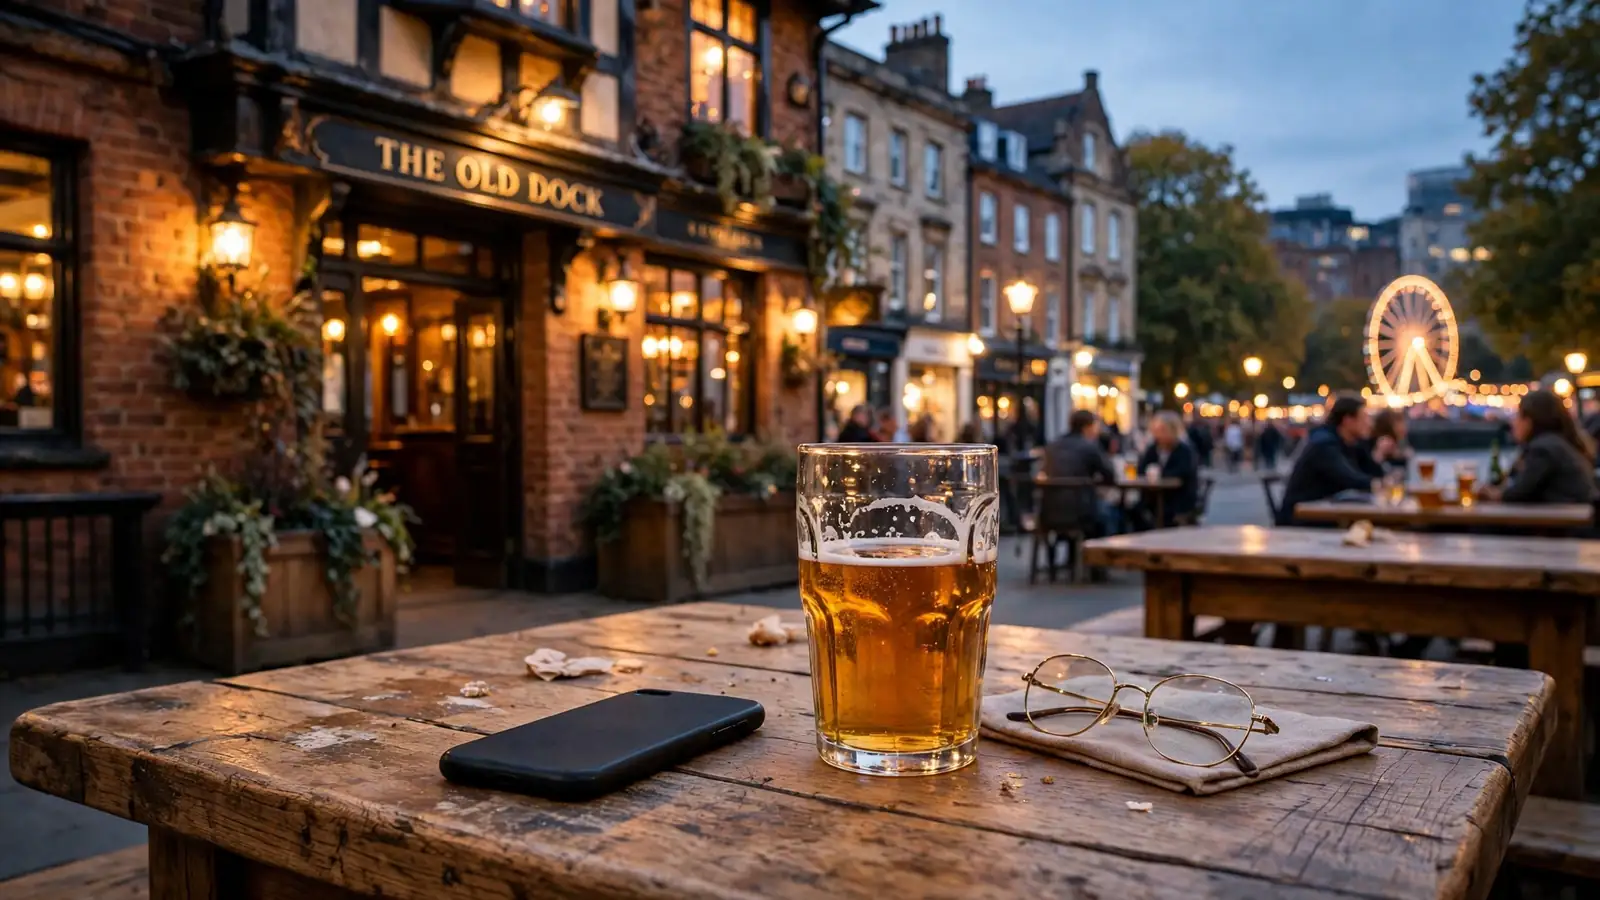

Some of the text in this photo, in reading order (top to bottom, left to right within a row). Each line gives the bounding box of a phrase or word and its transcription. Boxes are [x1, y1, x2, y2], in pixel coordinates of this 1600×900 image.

[375, 137, 604, 217] THE OLD DOCK
